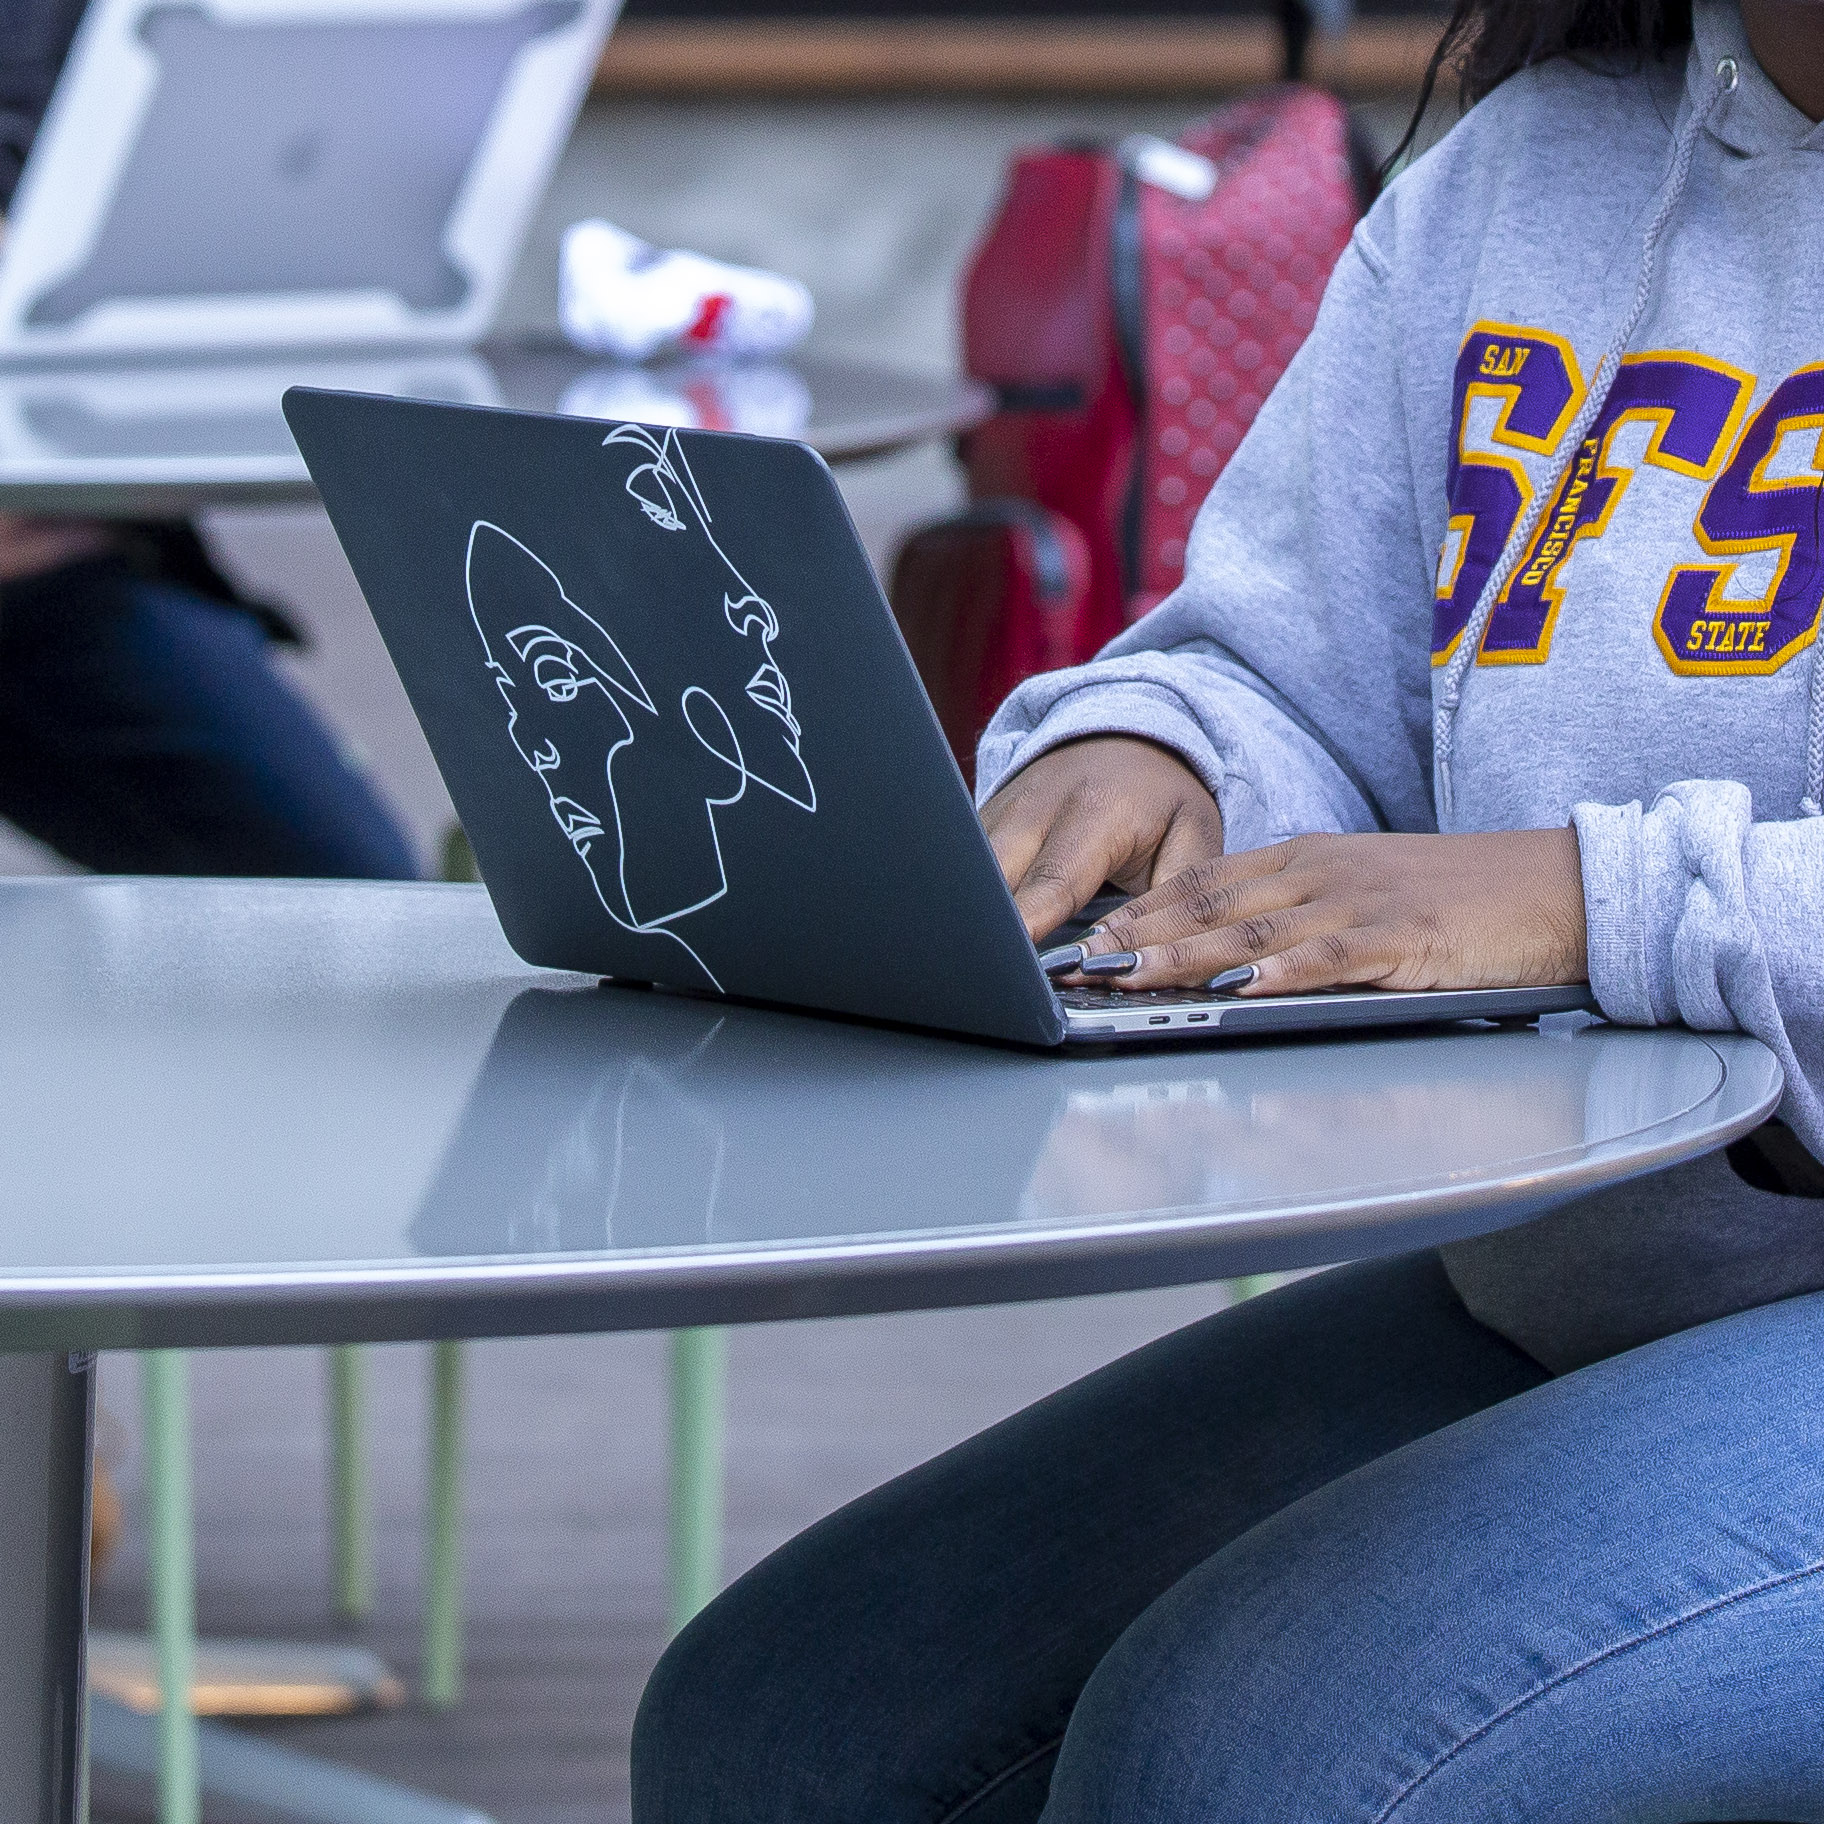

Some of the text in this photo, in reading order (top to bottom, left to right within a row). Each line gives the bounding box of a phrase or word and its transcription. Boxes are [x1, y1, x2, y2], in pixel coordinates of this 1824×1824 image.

[1479, 344, 1531, 376] SAN
[1520, 437, 1600, 587] FRANCISCO
[1686, 620, 1772, 653] STATE
